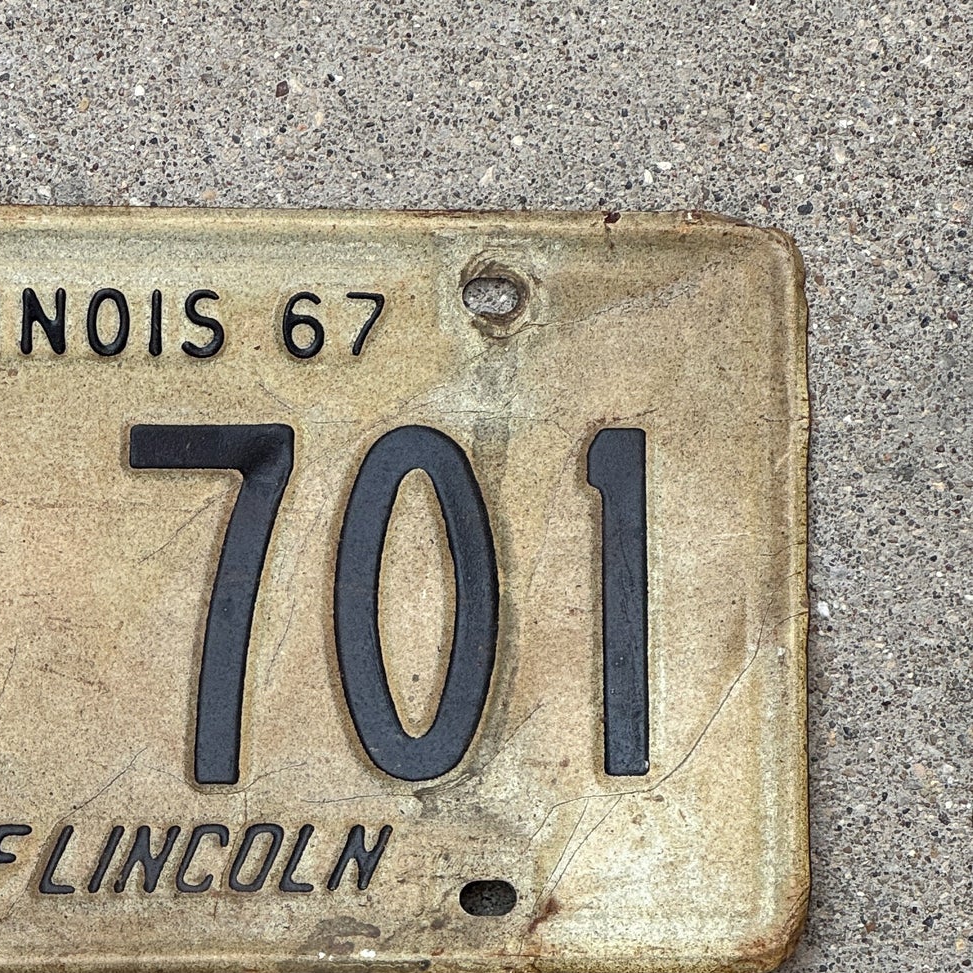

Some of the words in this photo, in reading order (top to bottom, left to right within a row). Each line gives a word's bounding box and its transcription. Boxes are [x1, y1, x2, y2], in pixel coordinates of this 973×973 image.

[282, 291, 386, 359] 67
[128, 422, 651, 786] 701
[38, 822, 394, 895] LINCOLN
